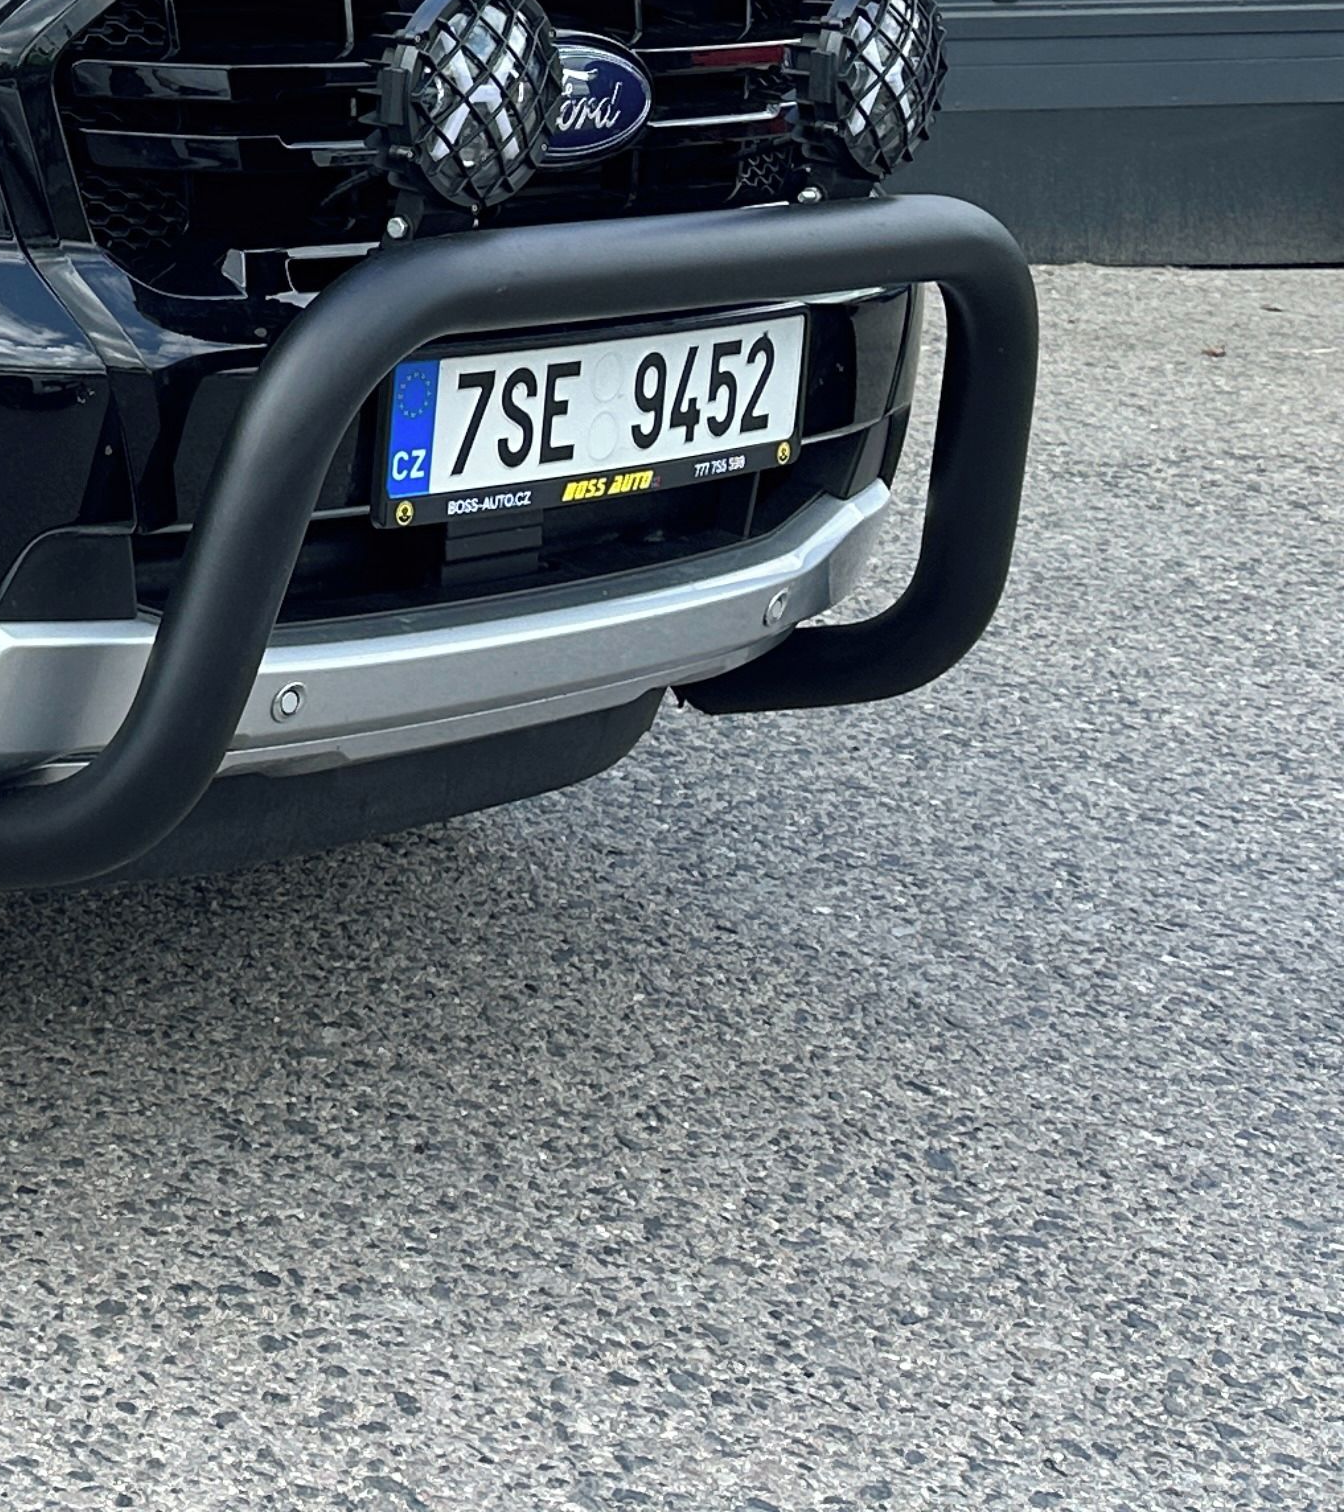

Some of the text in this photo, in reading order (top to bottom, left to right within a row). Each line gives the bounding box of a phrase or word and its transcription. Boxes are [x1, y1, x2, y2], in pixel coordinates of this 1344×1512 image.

[450, 333, 776, 478] 7SE 9452
[391, 448, 426, 481] CZ
[562, 470, 654, 502] BOSS AUTO
[447, 490, 532, 515] BOSS-AUTO.CZ
